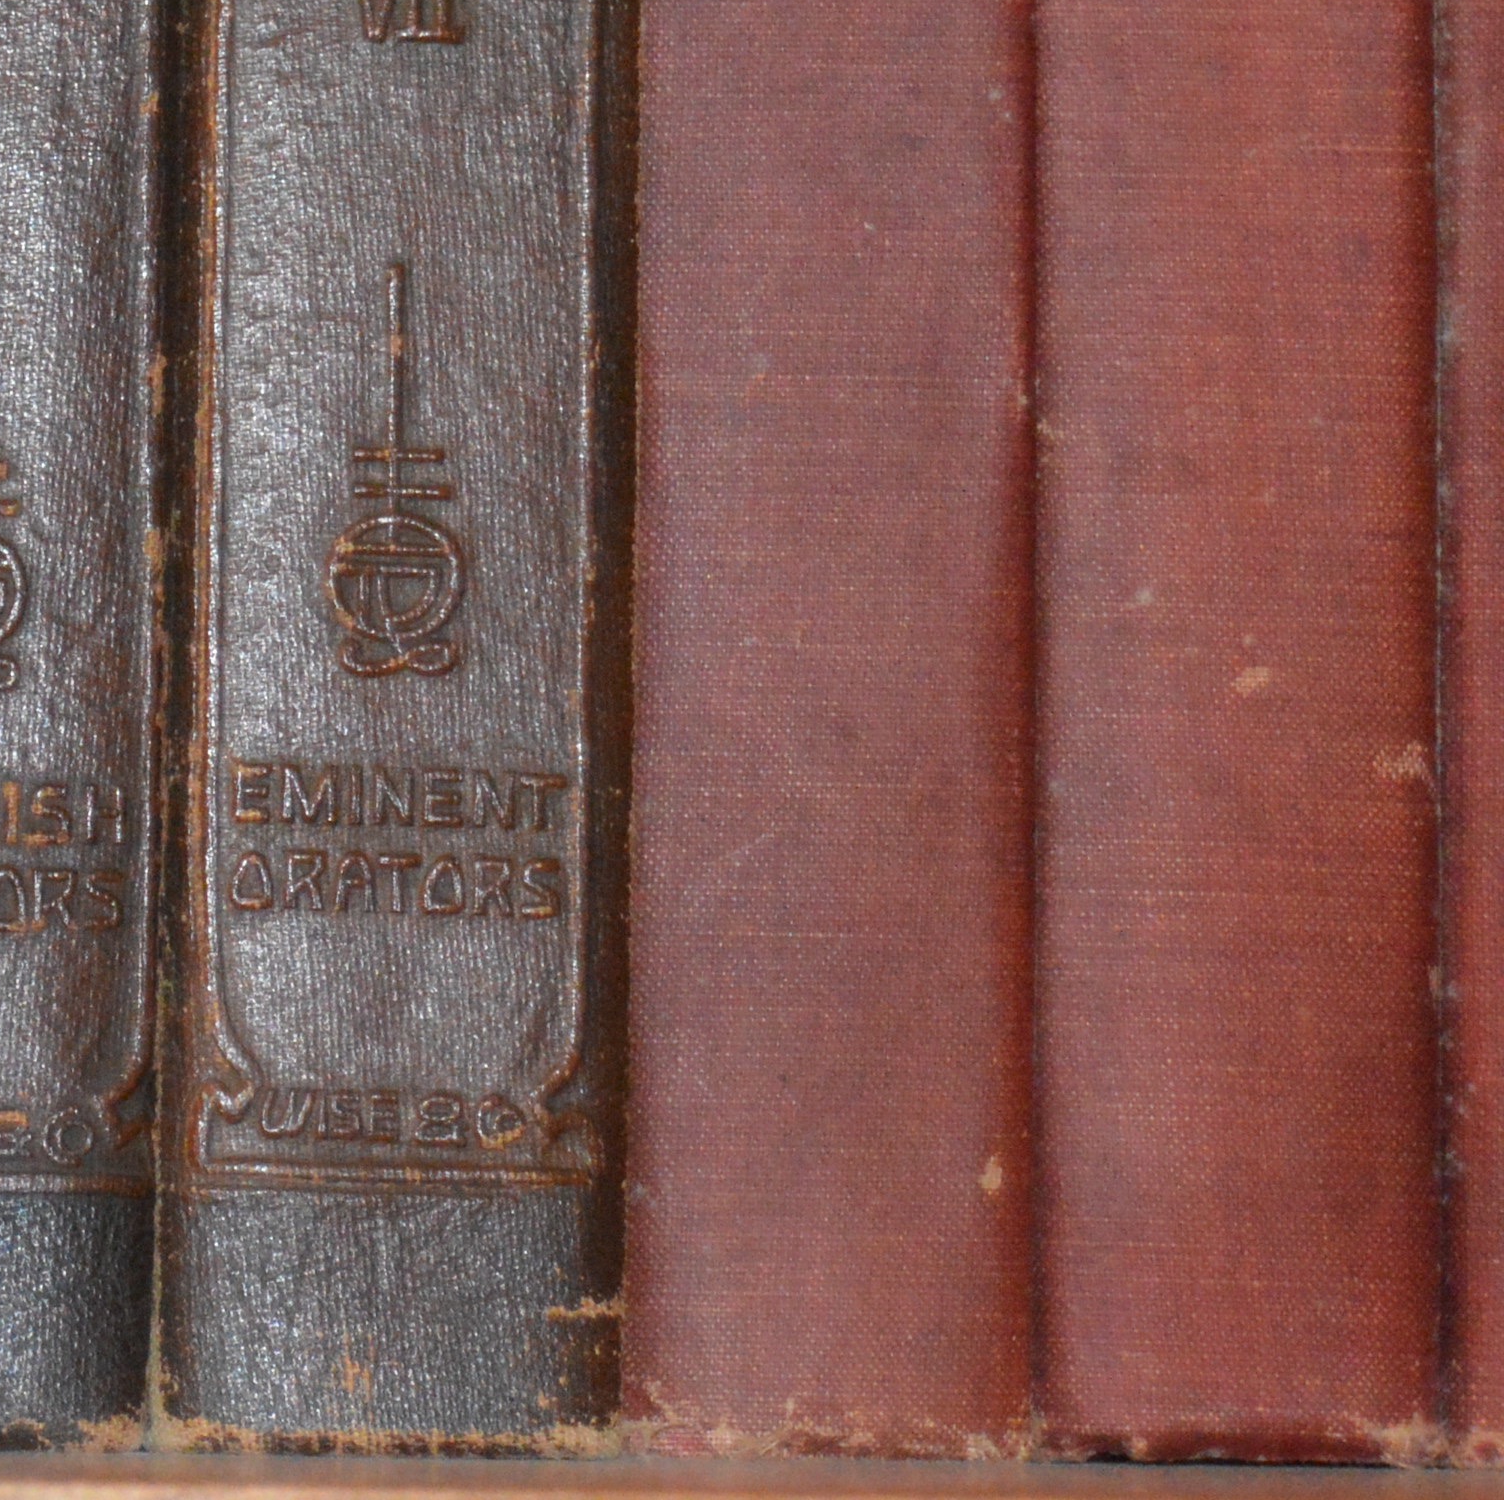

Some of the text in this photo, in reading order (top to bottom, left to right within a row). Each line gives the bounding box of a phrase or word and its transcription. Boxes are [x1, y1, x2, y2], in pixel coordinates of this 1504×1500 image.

[230, 762, 568, 831] EMINENT
[229, 849, 561, 918] ORATORS
[259, 1089, 398, 1142] WISE
